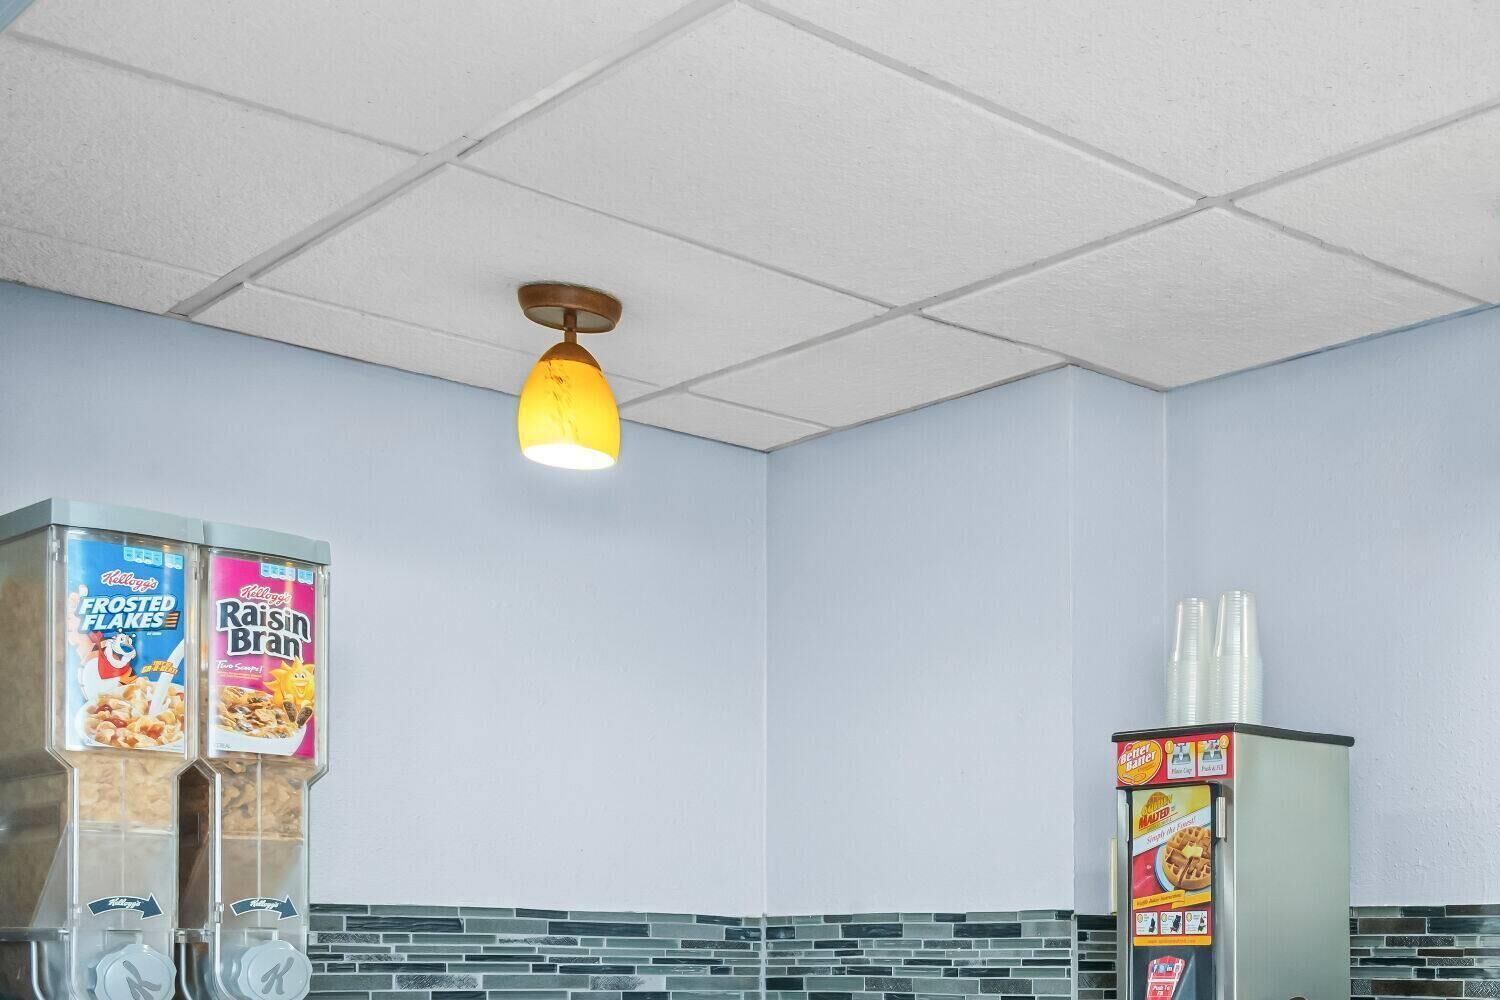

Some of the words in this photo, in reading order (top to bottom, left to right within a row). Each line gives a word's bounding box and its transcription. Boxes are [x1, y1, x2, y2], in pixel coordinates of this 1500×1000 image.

[102, 570, 158, 591] Kellogg's
[79, 596, 176, 614] FROSTED
[240, 584, 291, 606] Kellogg's
[82, 612, 164, 630] FLAKES
[218, 601, 309, 640] Raisin
[230, 628, 301, 658] Bran
[216, 660, 233, 669] Two
[1120, 743, 1151, 765] Better
[1126, 751, 1157, 772] Batter
[1139, 806, 1170, 829] MALTED
[109, 898, 141, 909] Kellogg's
[250, 899, 280, 909] Kellogg's
[260, 956, 295, 996] K
